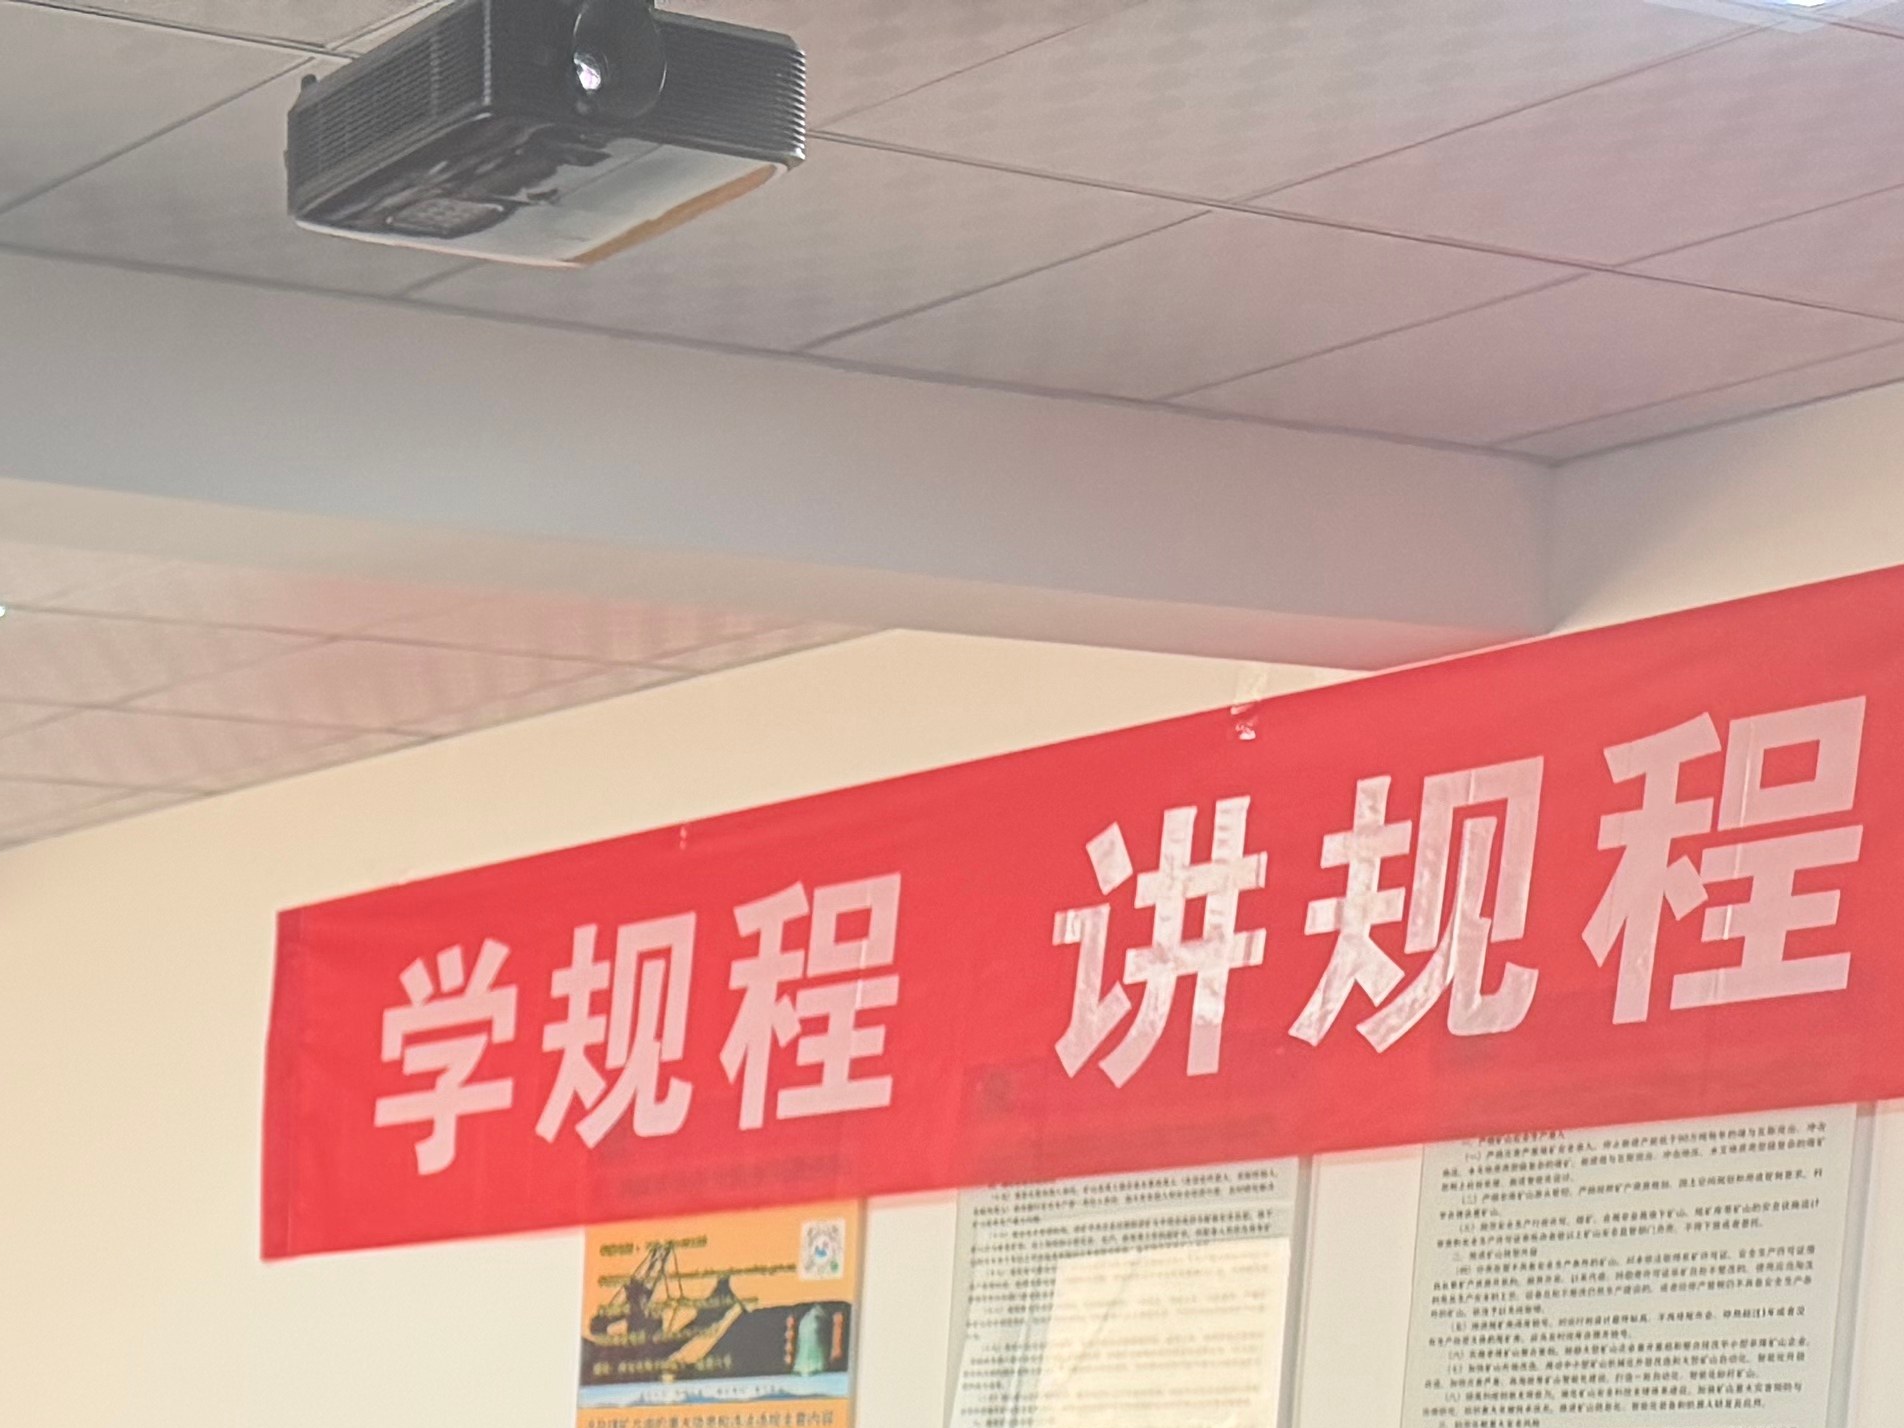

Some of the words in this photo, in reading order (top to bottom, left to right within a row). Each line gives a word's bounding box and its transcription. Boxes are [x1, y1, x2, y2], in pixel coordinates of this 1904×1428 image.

[373, 870, 902, 1176] 学规程
[1051, 694, 1868, 1090] 讲规程
